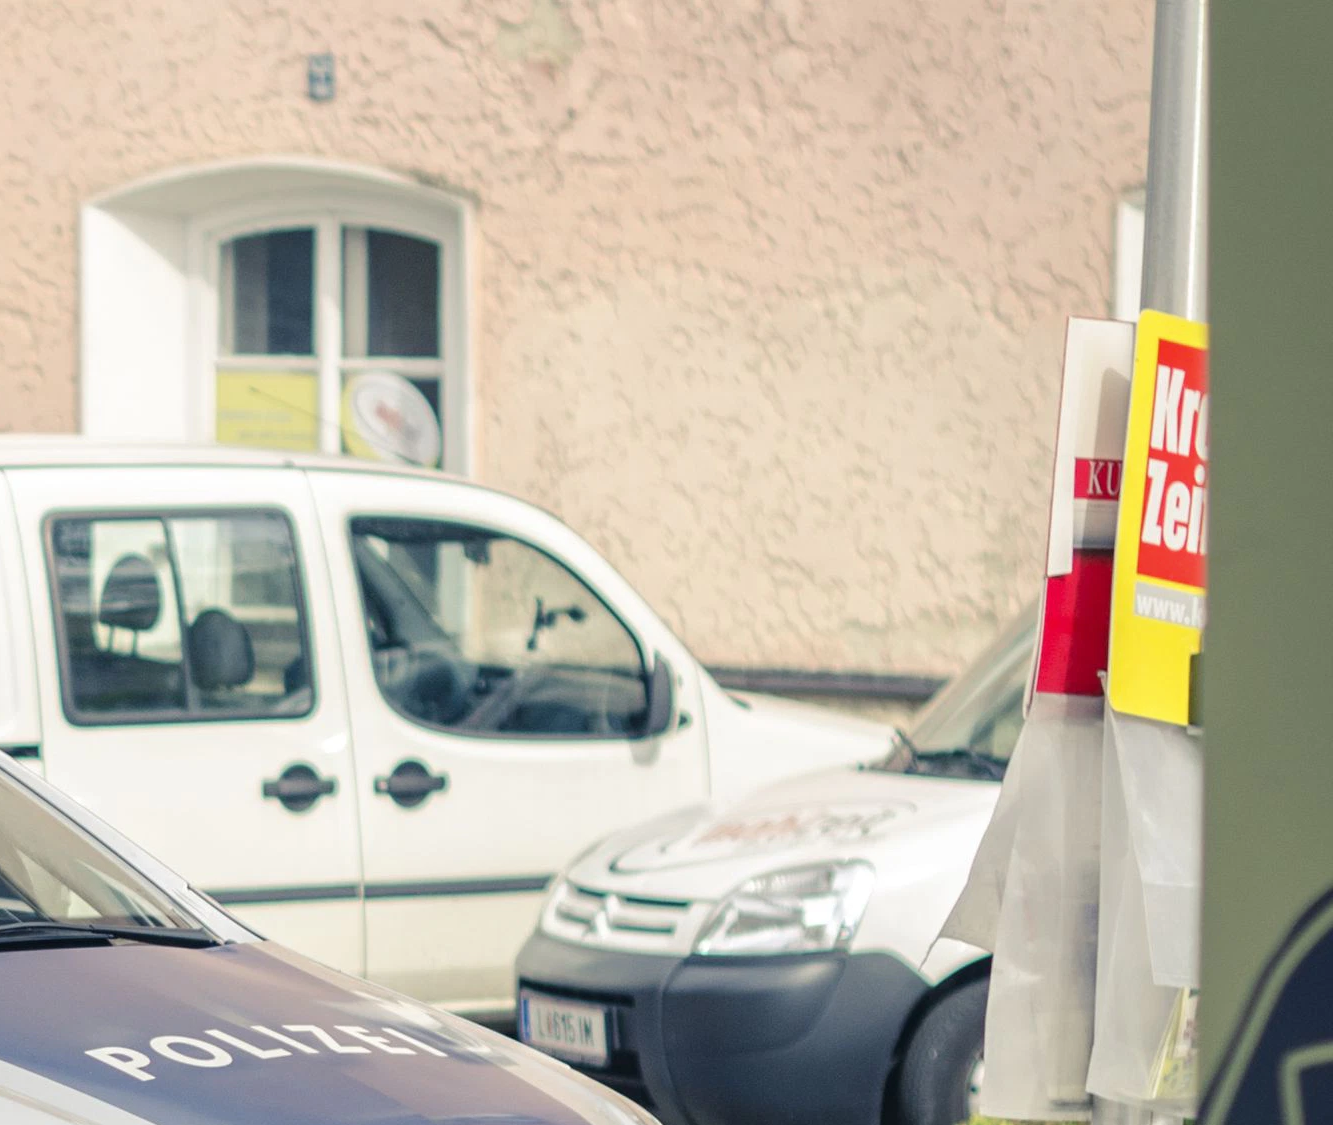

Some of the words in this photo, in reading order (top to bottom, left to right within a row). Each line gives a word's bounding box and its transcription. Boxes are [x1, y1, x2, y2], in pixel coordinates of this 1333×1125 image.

[1087, 460, 1121, 496] KU
[1141, 458, 1206, 556] Zei
[84, 1024, 448, 1082] POLIZEI
